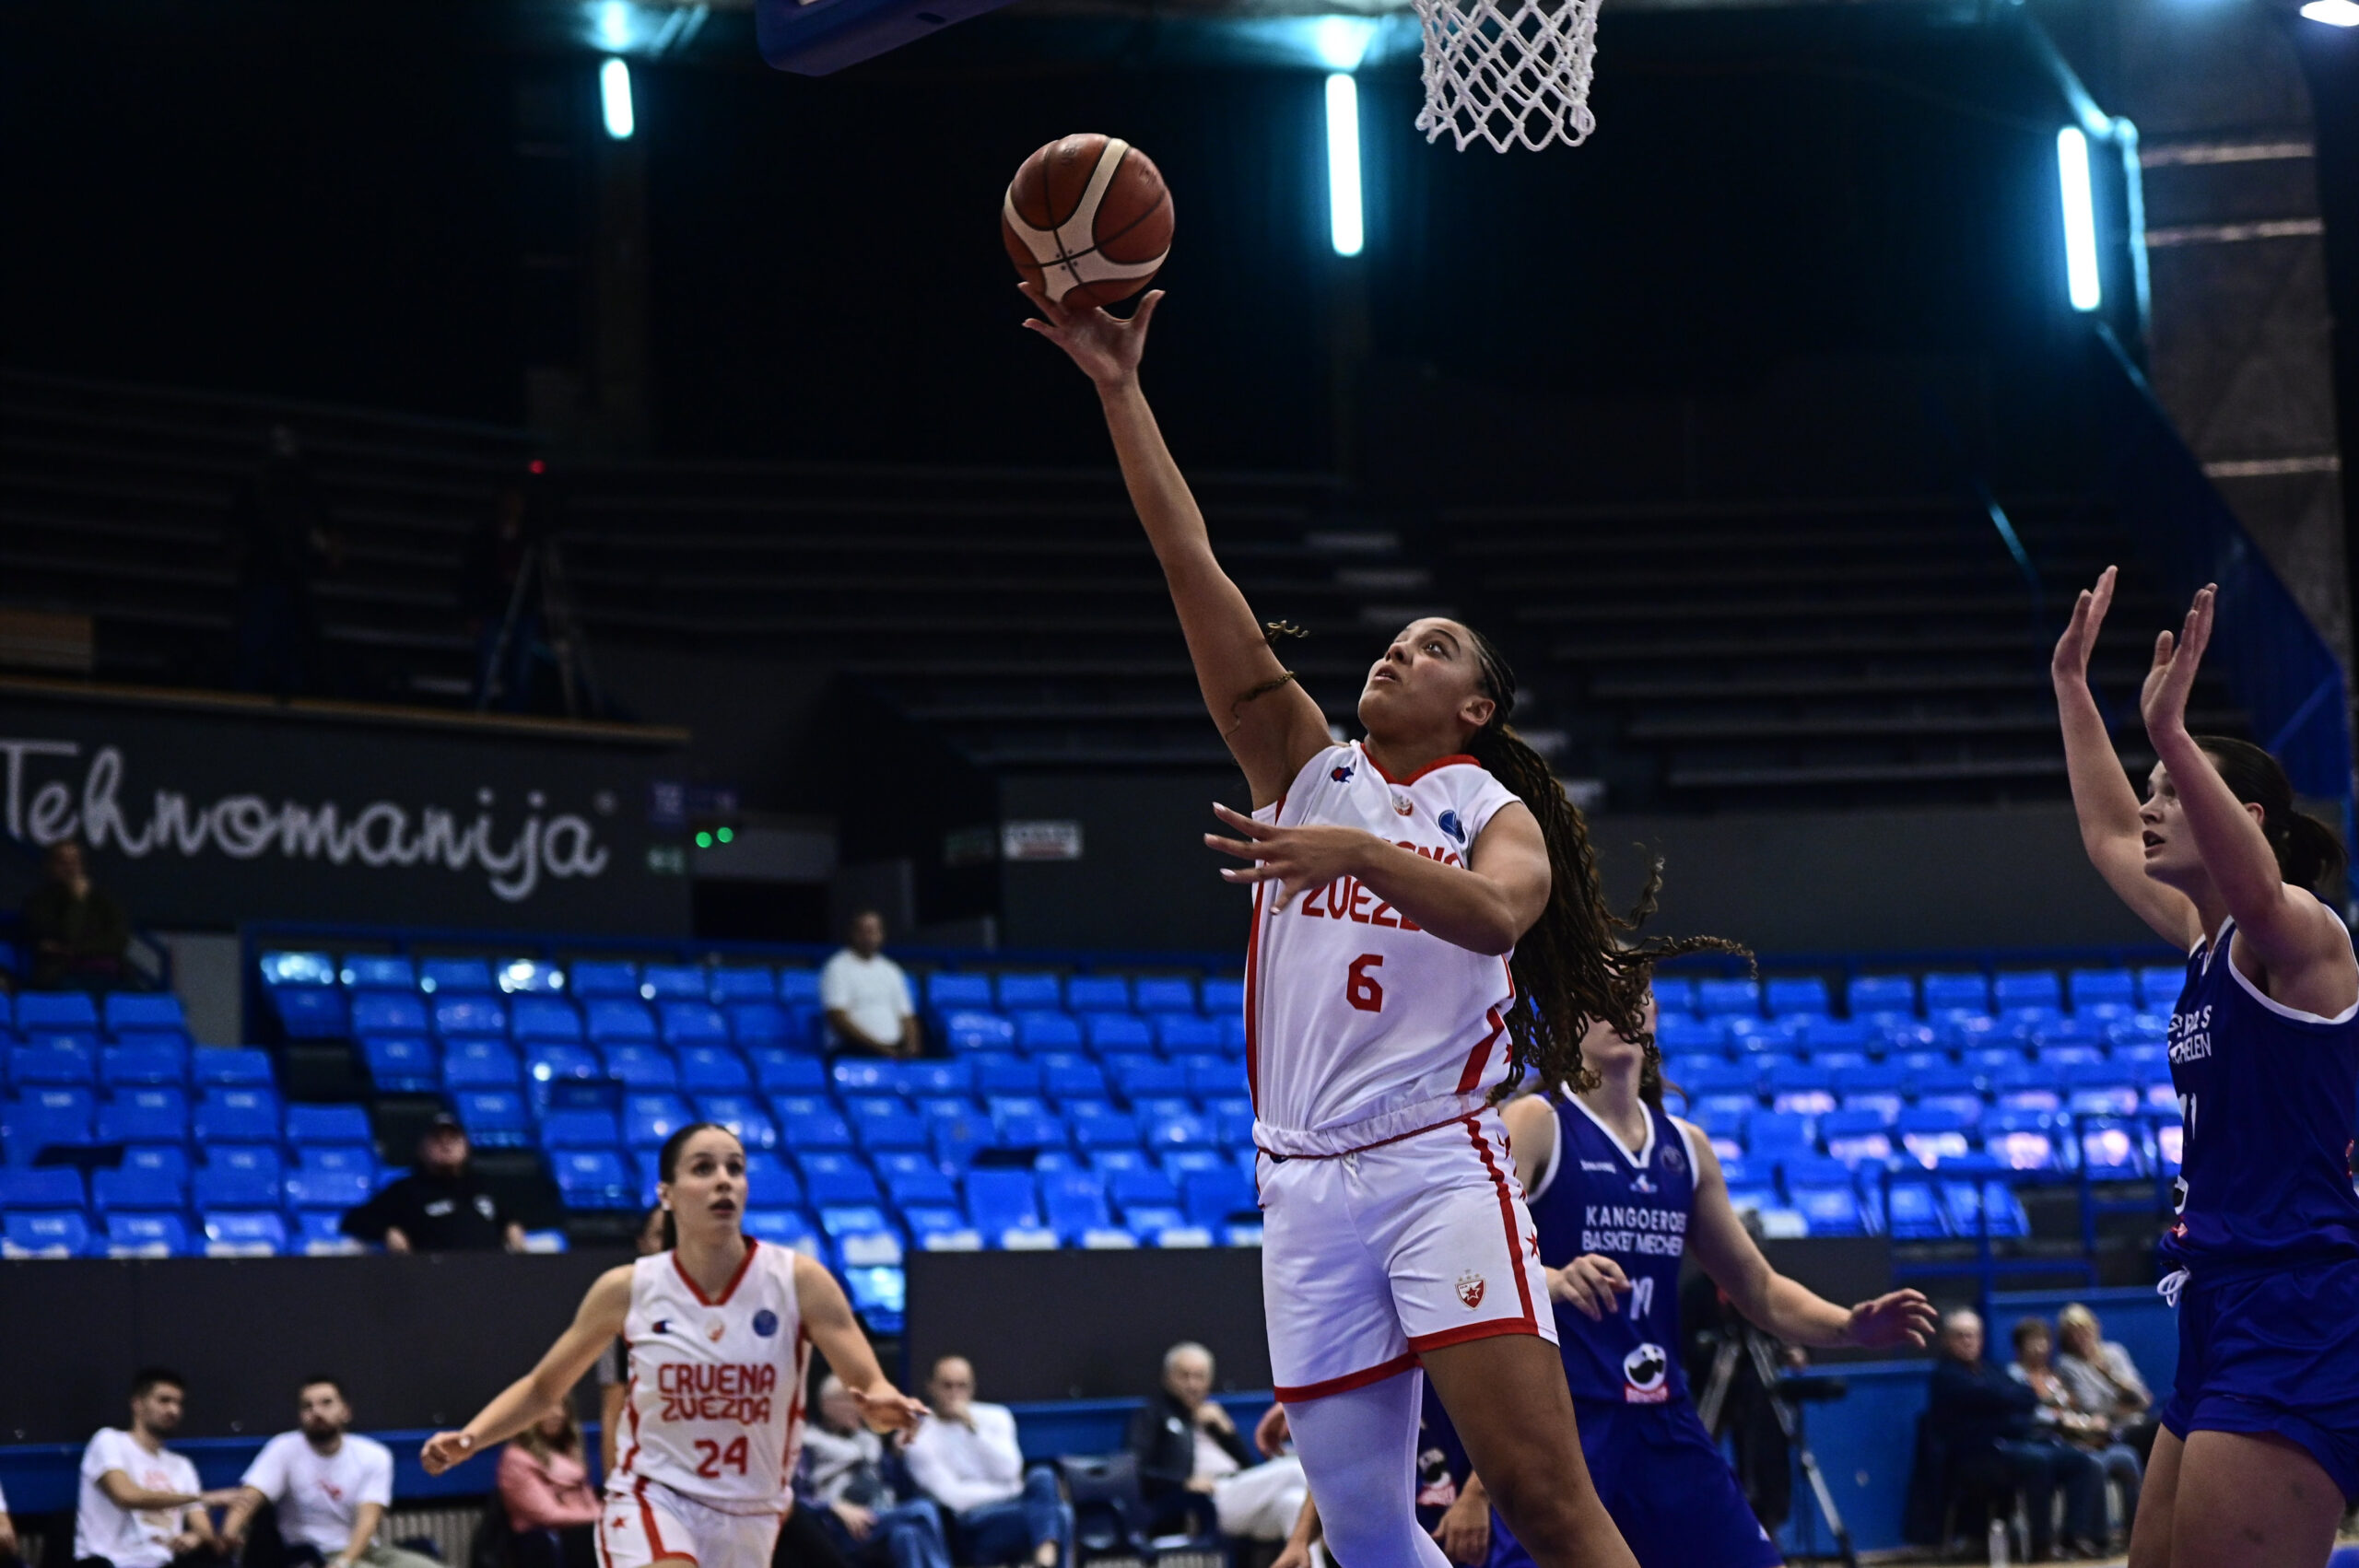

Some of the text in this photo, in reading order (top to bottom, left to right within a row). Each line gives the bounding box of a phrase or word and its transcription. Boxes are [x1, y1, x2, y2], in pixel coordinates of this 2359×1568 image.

[0, 741, 609, 902] Tehnomanija
[1346, 954, 1383, 1013] 6
[1582, 1230, 1635, 1252] BASKET
[694, 1434, 748, 1480] 24
